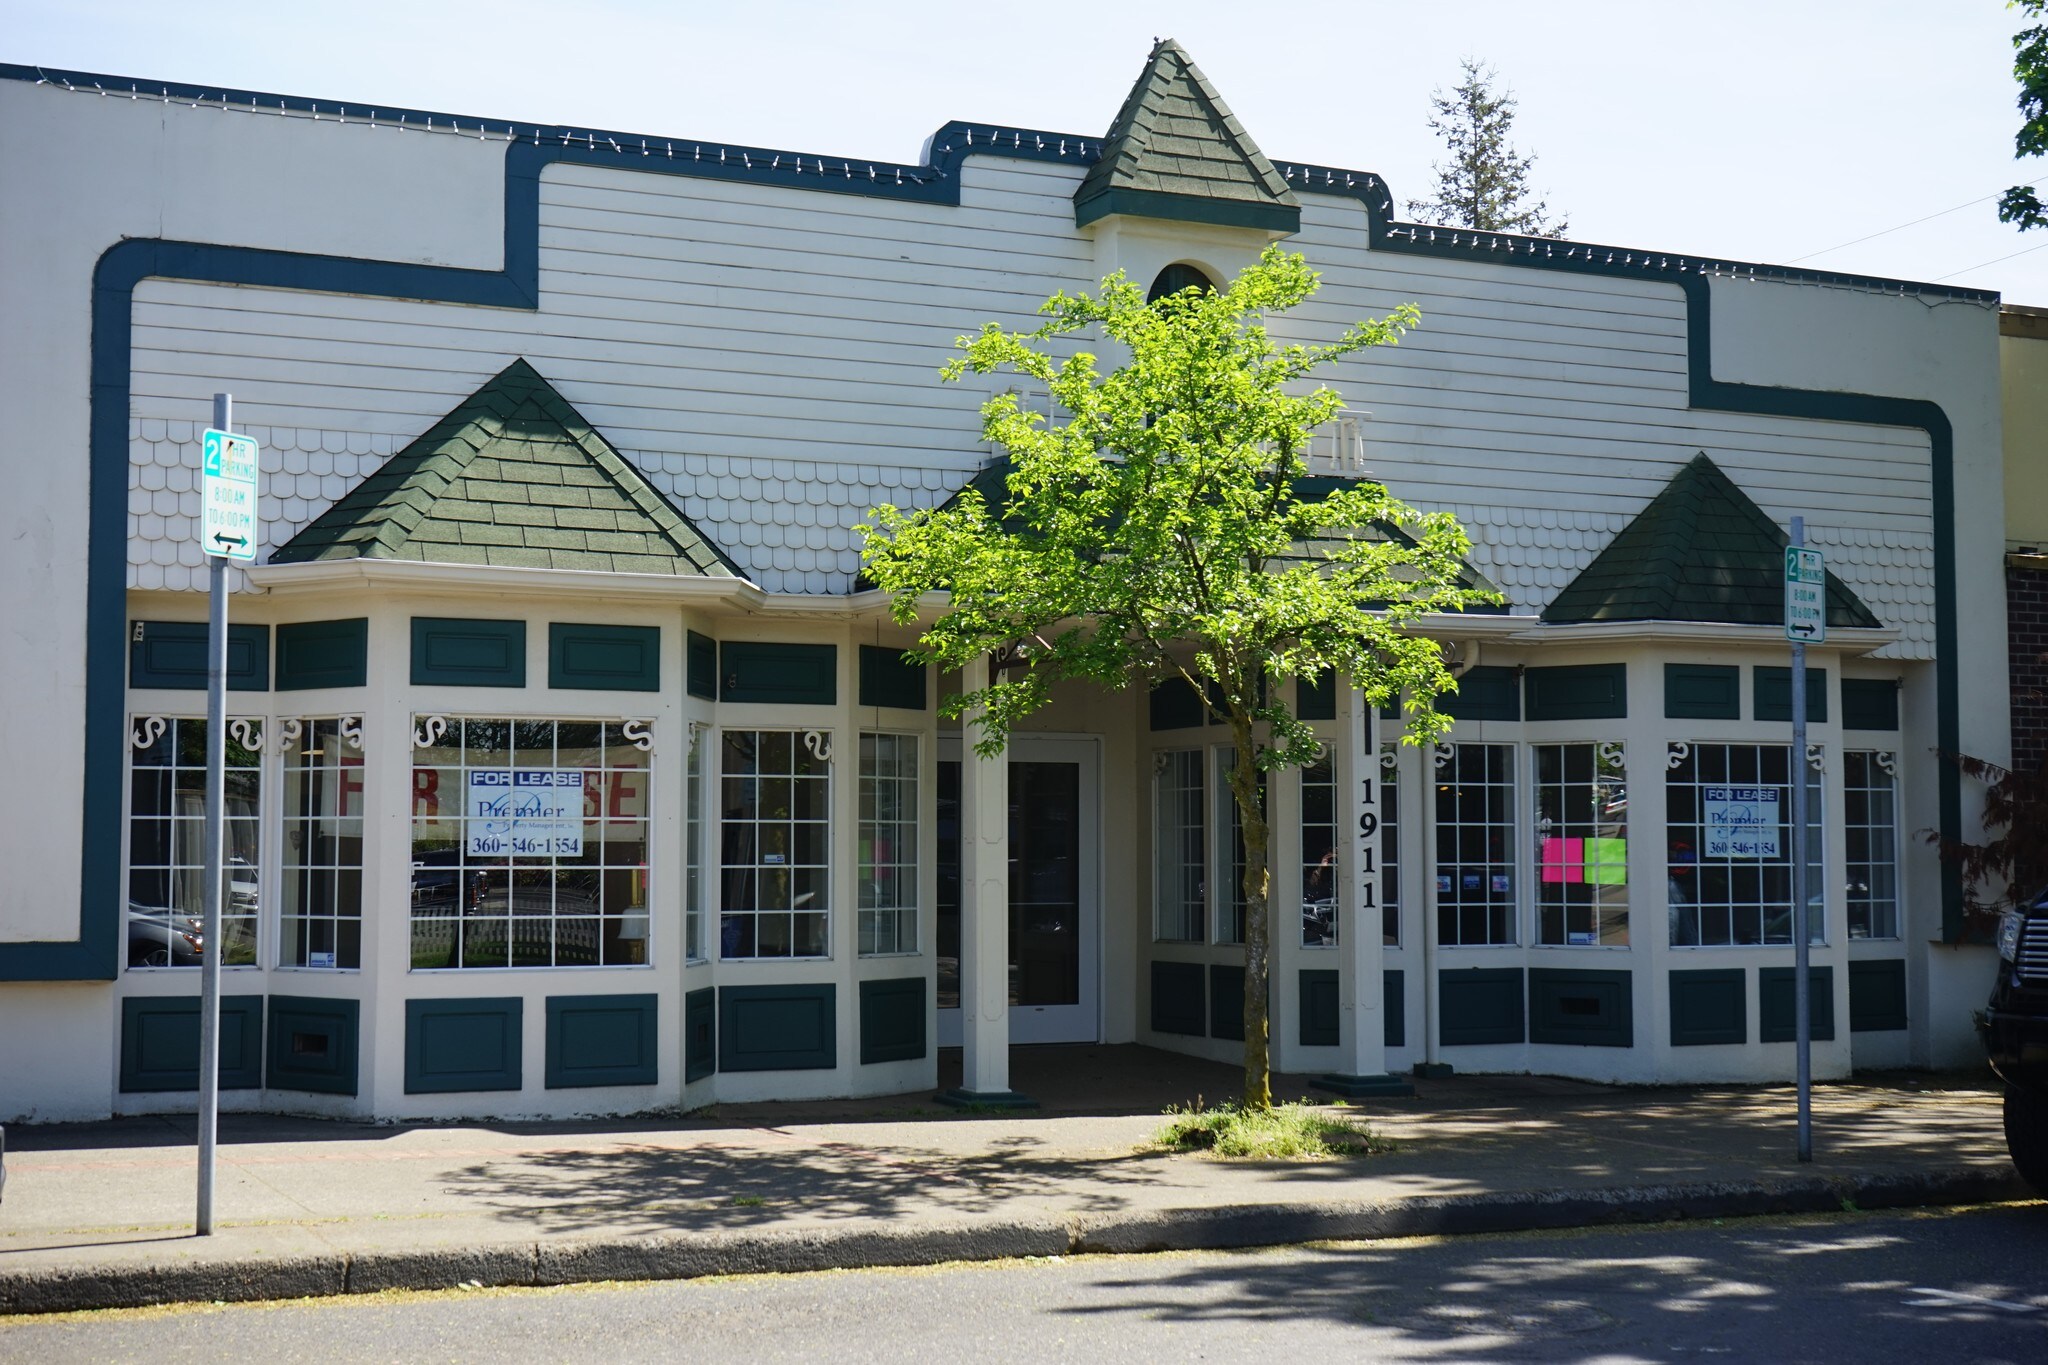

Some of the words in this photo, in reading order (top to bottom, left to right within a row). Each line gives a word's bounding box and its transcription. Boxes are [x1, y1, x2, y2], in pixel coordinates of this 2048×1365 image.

[206, 439, 219, 470] 2
[221, 458, 254, 480] PARKING
[214, 486, 232, 504] 8:00
[234, 490, 246, 506] AM
[208, 508, 219, 525] TO
[220, 510, 238, 528] 6:00
[239, 513, 251, 529] PM
[1788, 553, 1798, 576] 2
[472, 772, 512, 785] FOR
[519, 772, 580, 786] LEASE
[1737, 790, 1775, 801] LEASE
[477, 800, 565, 820] Premier
[1359, 778, 1377, 908] 1911
